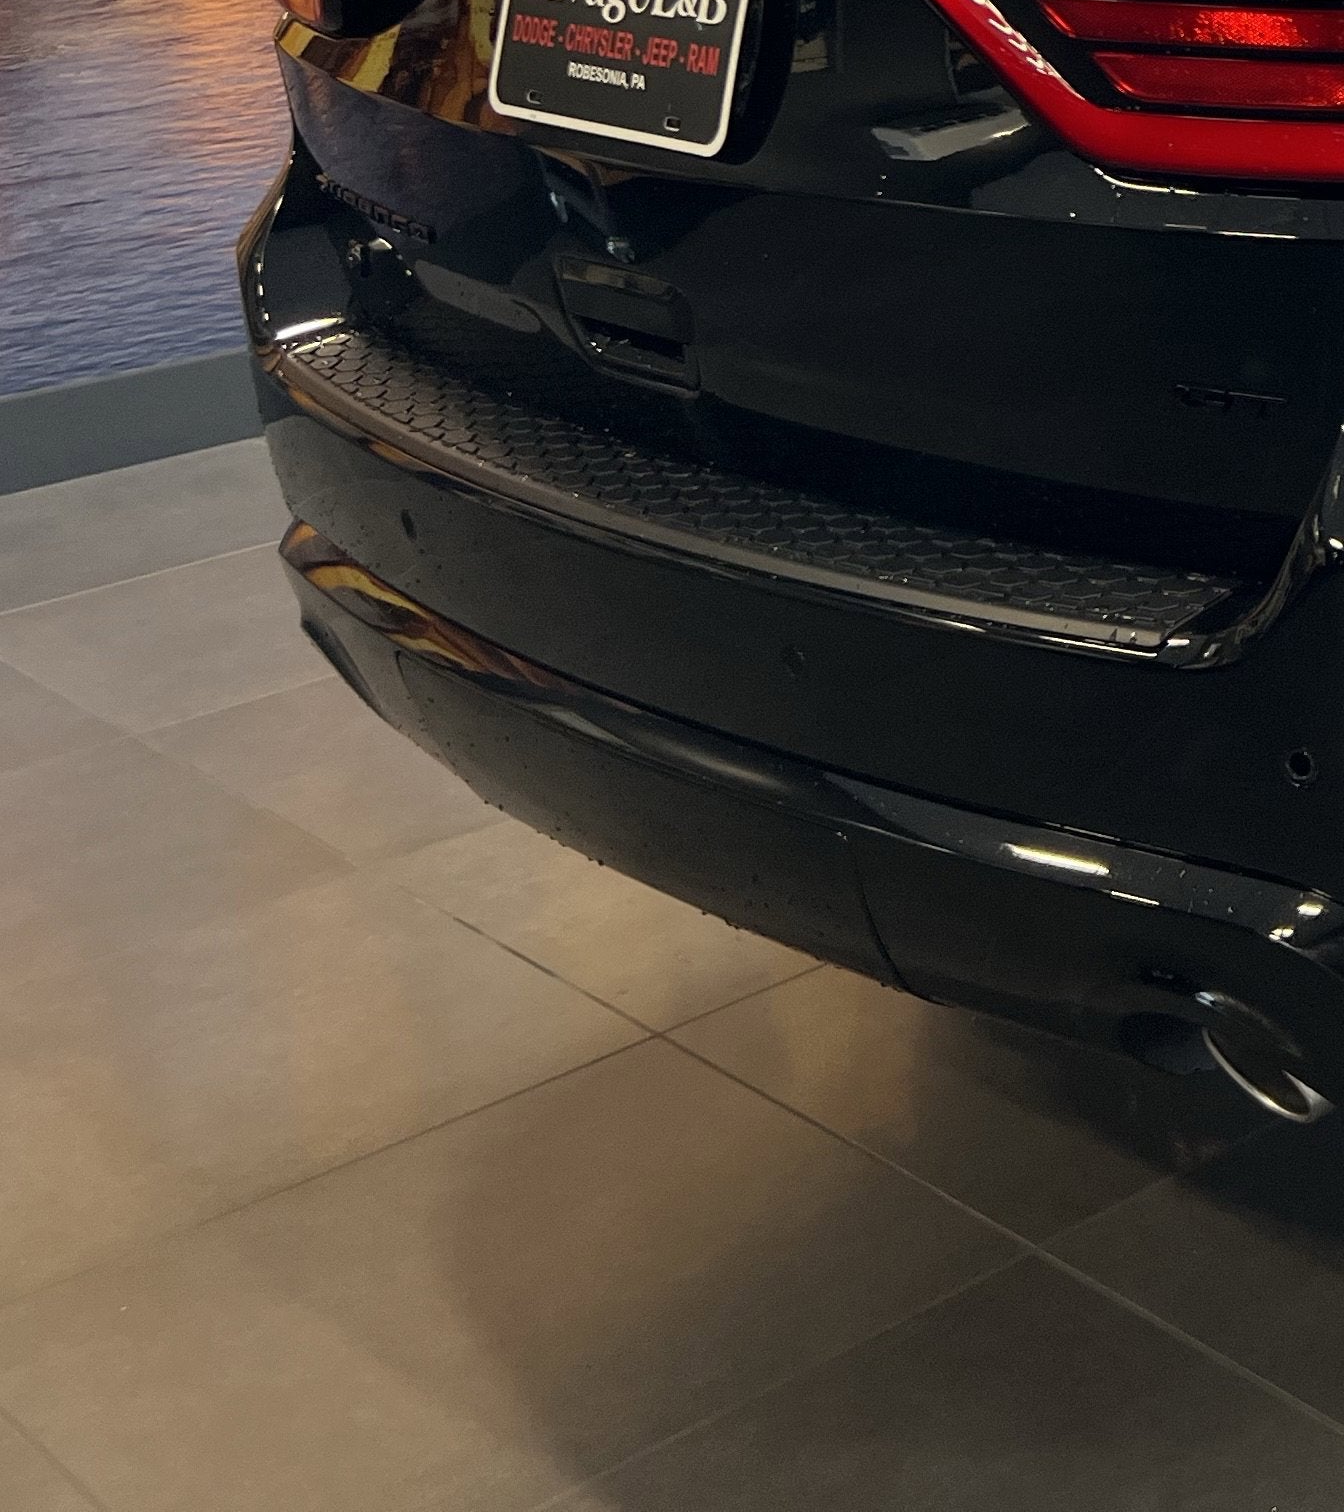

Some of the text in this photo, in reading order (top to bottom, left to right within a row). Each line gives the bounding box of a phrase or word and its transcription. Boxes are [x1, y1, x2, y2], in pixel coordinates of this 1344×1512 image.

[512, 14, 559, 48] DODGE
[564, 23, 634, 61] CHRYSLER
[642, 35, 678, 68] JEEP
[686, 43, 720, 77] RAM
[630, 72, 646, 90] PA
